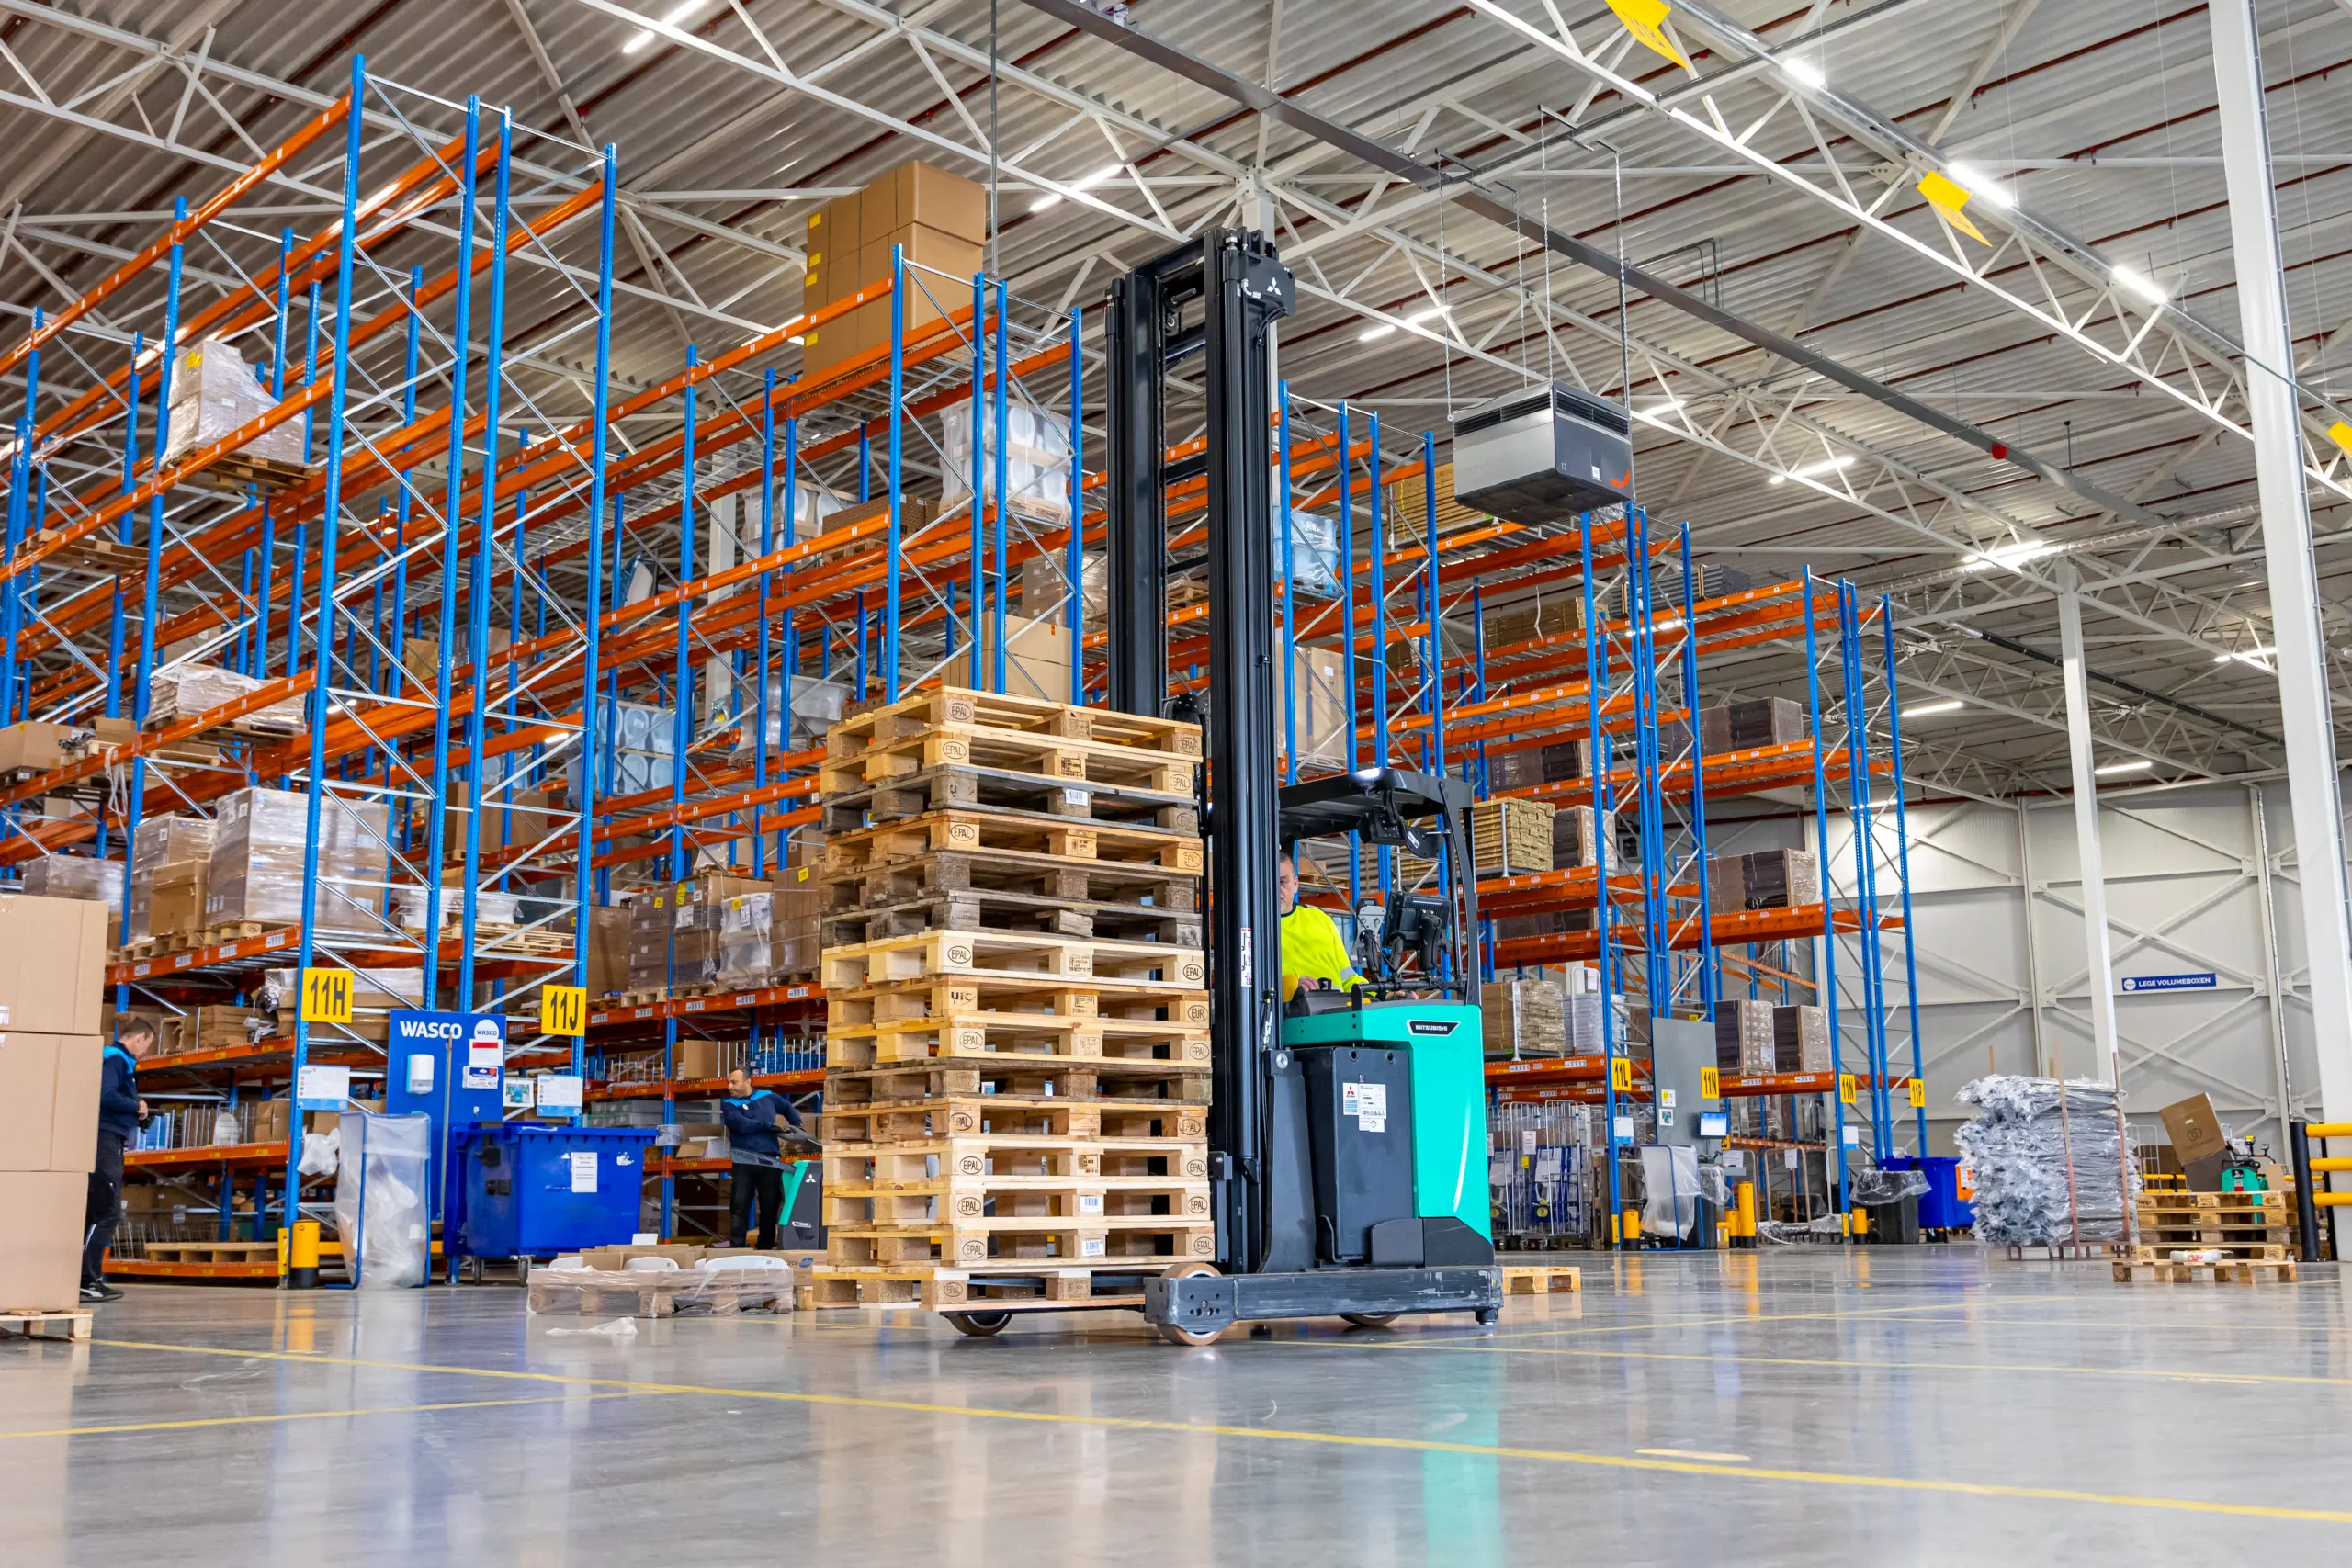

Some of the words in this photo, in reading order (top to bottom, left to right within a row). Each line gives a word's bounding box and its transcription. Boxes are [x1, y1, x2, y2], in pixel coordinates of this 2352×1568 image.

[951, 706, 968, 716] EPAL
[945, 744, 963, 756] EPAL
[953, 827, 971, 838] EPAL
[952, 949, 967, 960] EPAL
[1186, 965, 1201, 976] EPAL
[2157, 977, 2211, 986] VOLUMEBOXEN
[311, 975, 346, 1017] 11H
[550, 991, 579, 1030] 11J
[1191, 1008, 1204, 1019] EUR
[400, 1021, 463, 1040] WASCO
[963, 1035, 978, 1045] EPAL
[1192, 1046, 1207, 1056] EPAL
[1614, 1062, 1629, 1087] 11L
[1703, 1071, 1717, 1095] 11N
[1842, 1078, 1854, 1100] 11N
[1912, 1082, 1922, 1103] 11P
[963, 1160, 979, 1170] EPAL
[1189, 1162, 1204, 1173] EPAL
[961, 1201, 978, 1212] EPAL
[1190, 1200, 1205, 1210] EPAL
[966, 1245, 983, 1255] EPAL
[1196, 1240, 1212, 1250] EPAL
